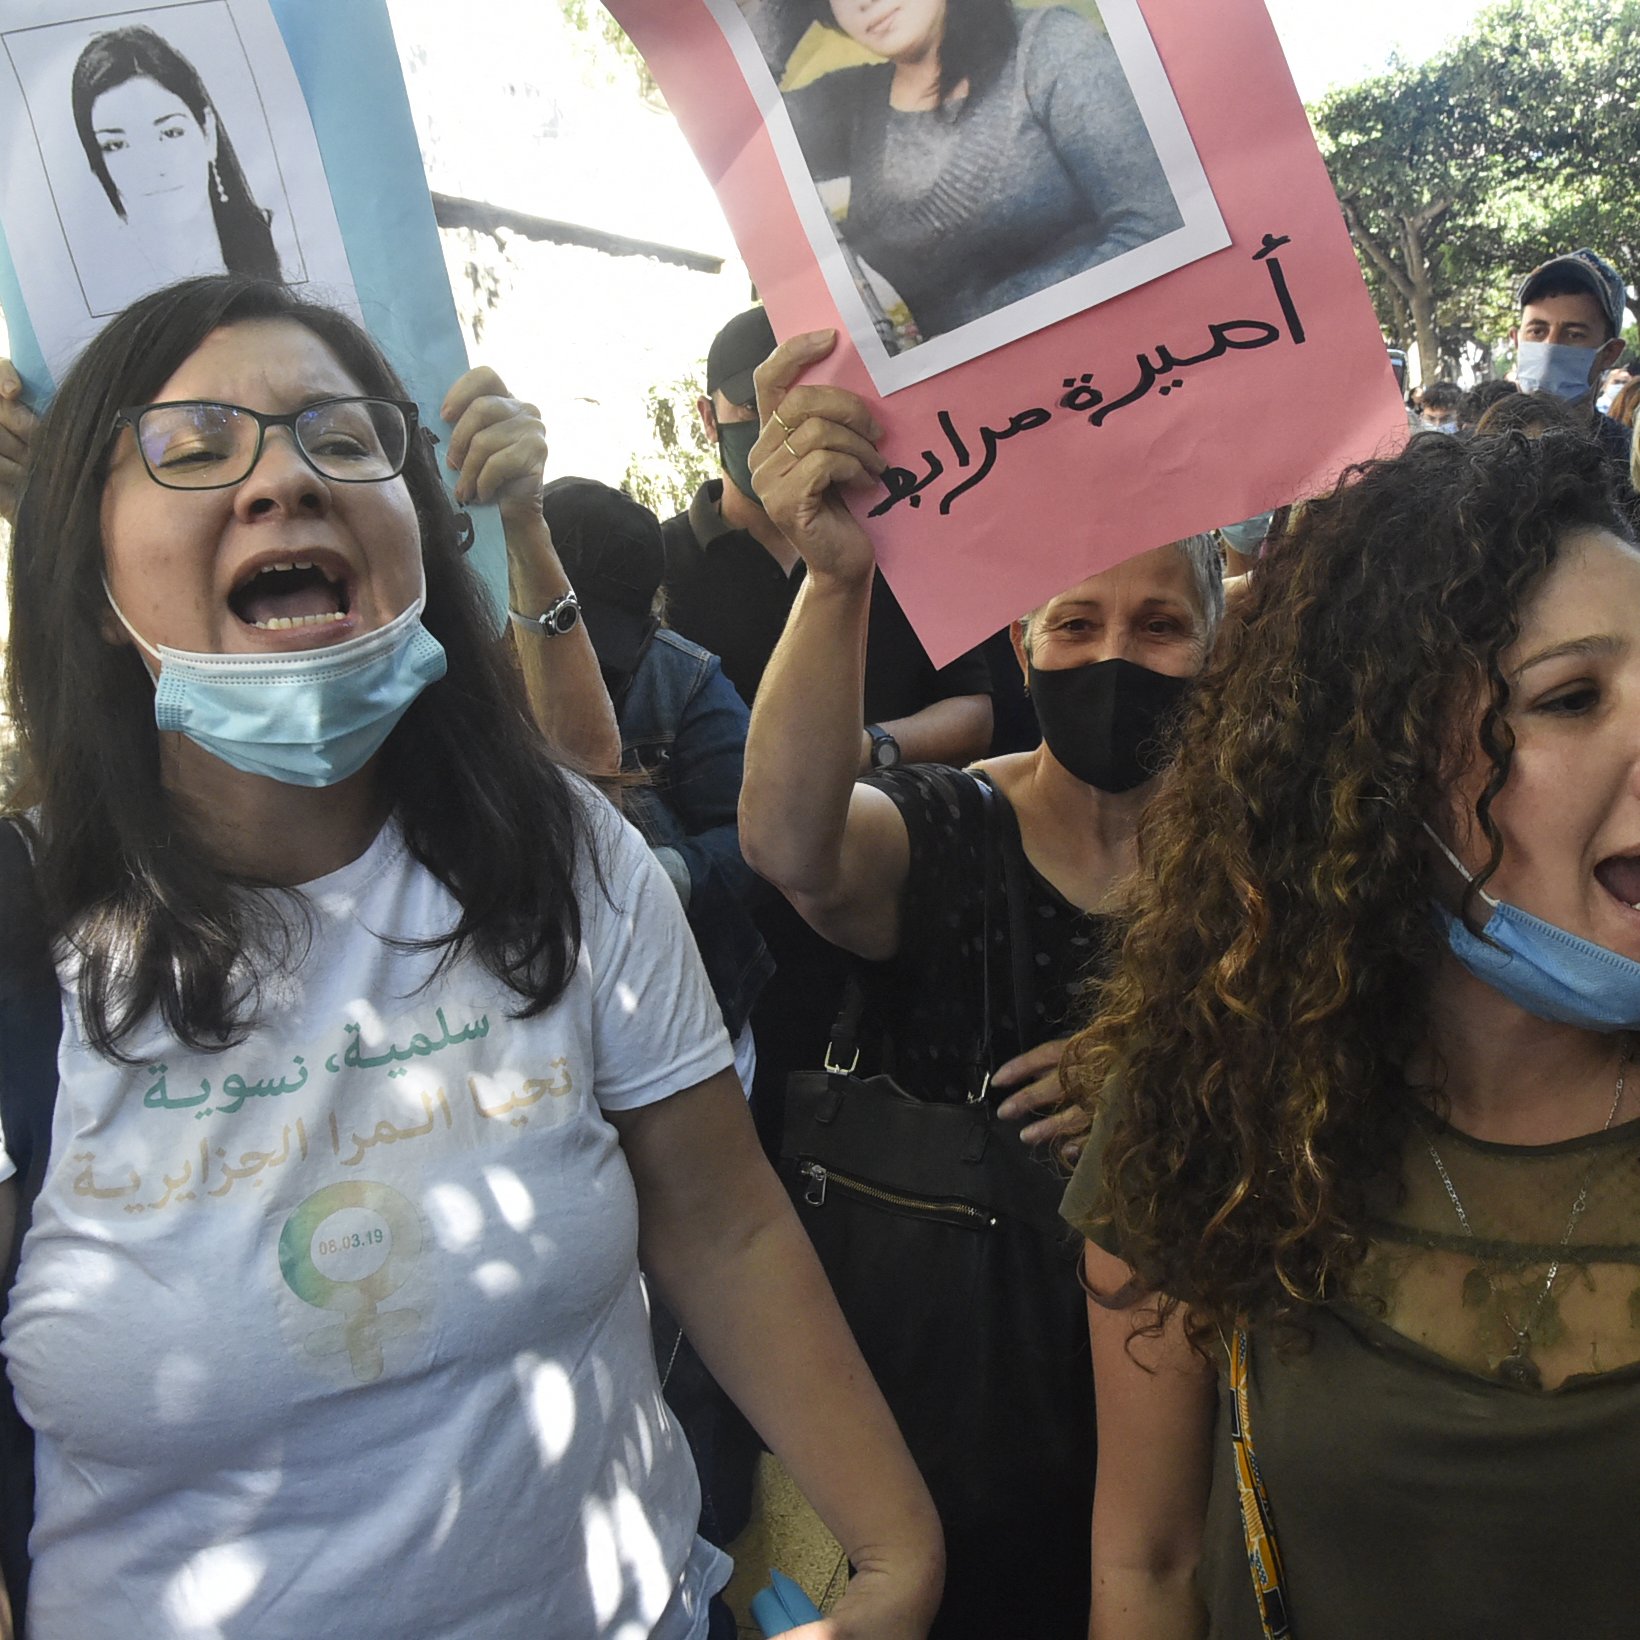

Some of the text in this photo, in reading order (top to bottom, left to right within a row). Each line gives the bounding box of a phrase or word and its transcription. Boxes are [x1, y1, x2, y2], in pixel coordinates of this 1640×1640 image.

[1059, 233, 1306, 427] أميرة
[73, 1056, 573, 1214] تحيا المرا الجزايرية
[143, 1054, 309, 1120] نسوية
[318, 1228, 384, 1256] 08.03.19
